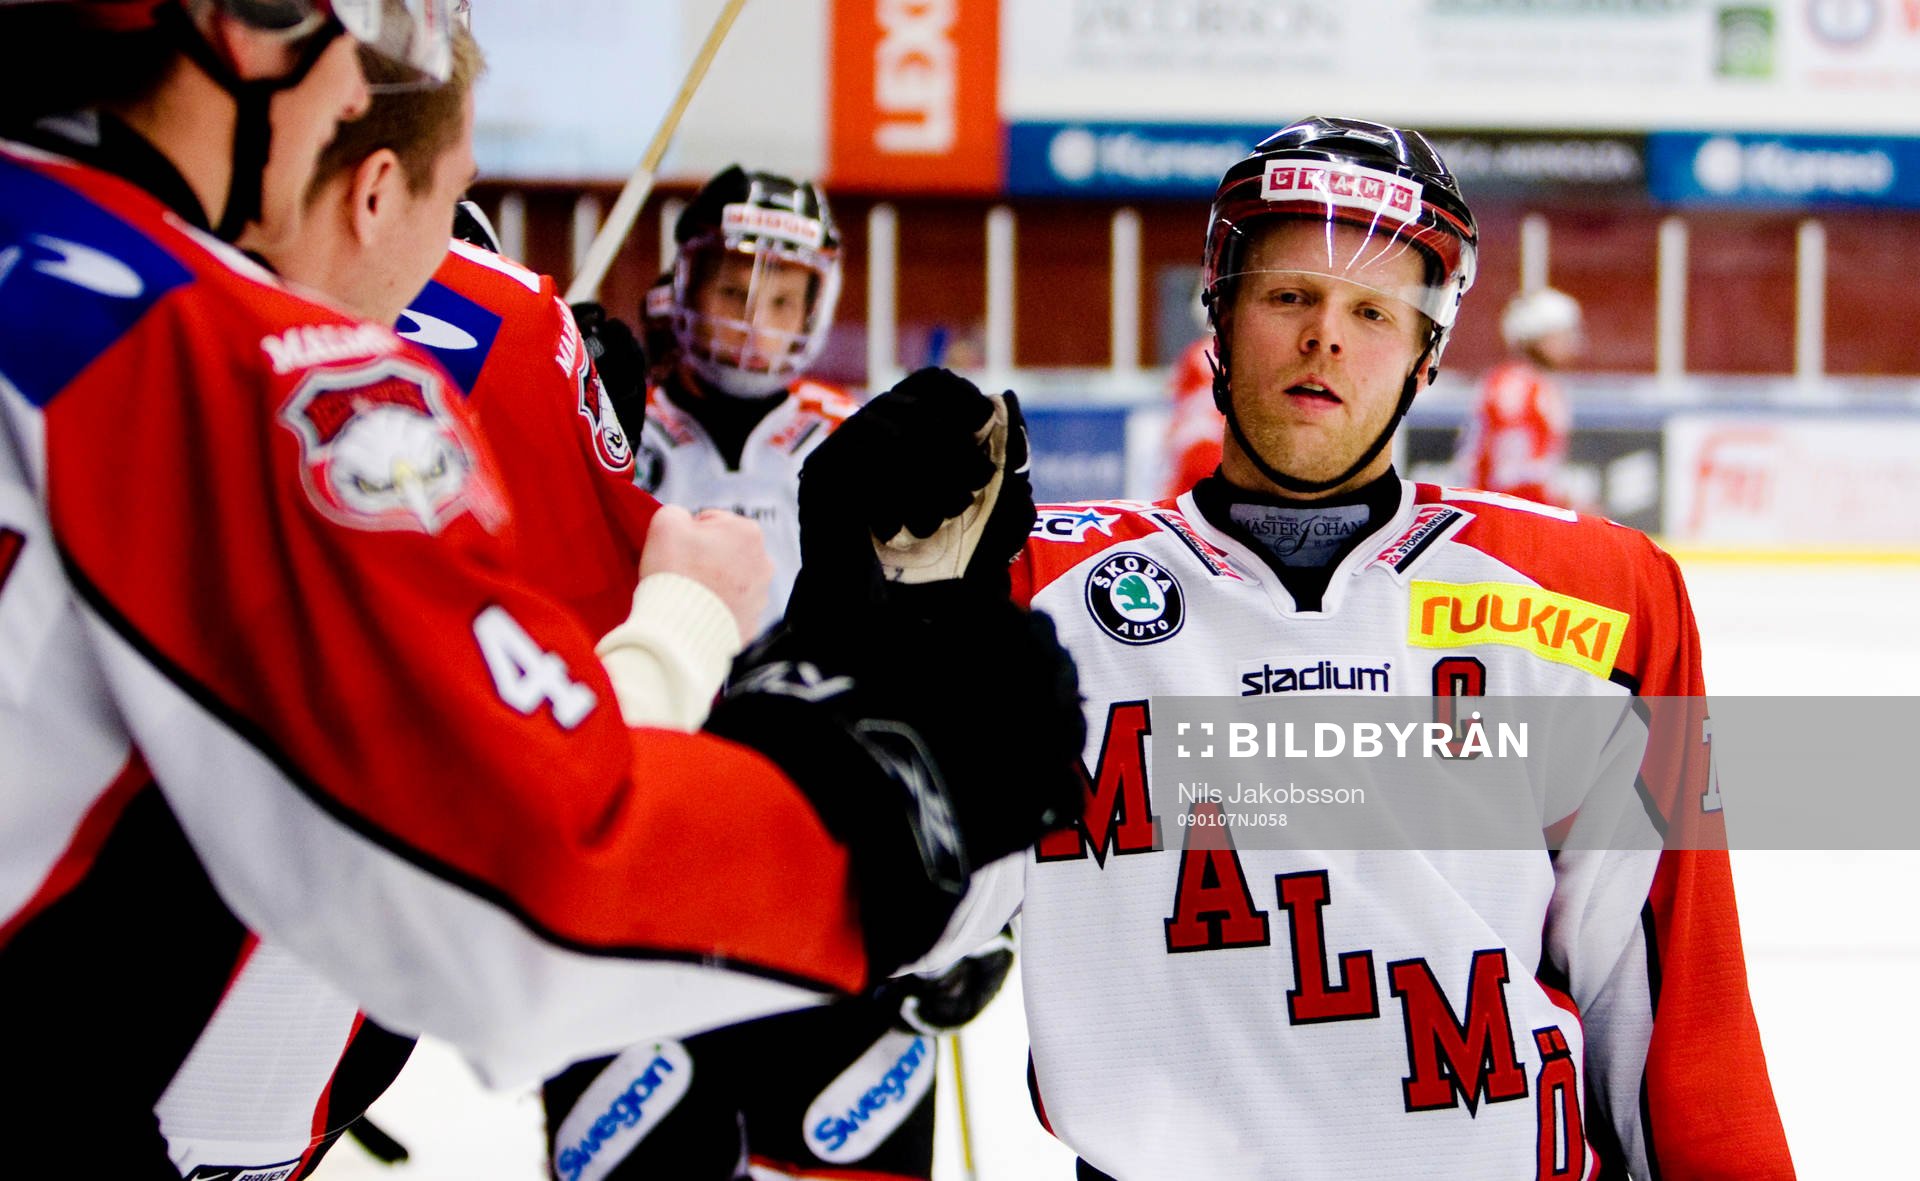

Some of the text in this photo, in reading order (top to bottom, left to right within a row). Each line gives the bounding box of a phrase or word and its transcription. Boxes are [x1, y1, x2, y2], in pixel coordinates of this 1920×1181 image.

[1399, 508, 1453, 554] STORMARKNAD
[473, 604, 597, 729] 4
[1117, 620, 1169, 636] AUTO
[1241, 661, 1389, 697] stadium
[1432, 656, 1486, 760] C
[557, 1056, 674, 1181] Swegon
[815, 1036, 927, 1152] Swegon
